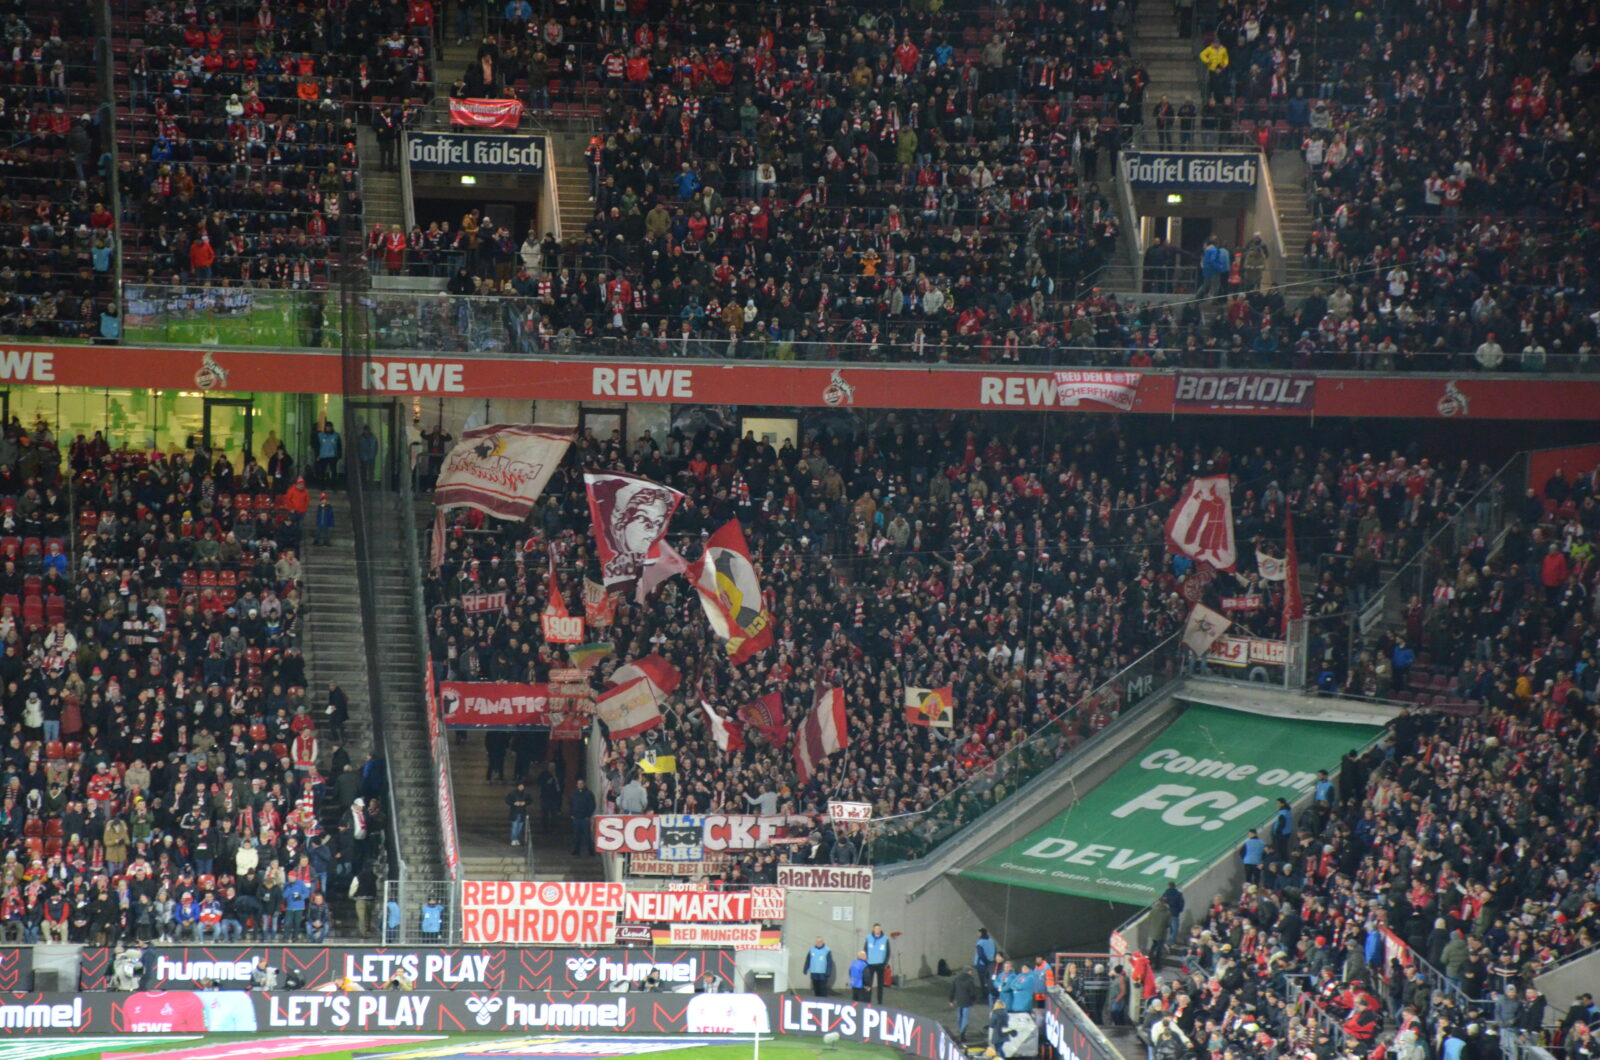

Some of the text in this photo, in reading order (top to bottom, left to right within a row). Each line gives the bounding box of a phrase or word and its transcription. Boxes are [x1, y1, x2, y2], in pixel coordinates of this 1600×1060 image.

[409, 136, 543, 169] Gaffel Kölsch
[1126, 156, 1256, 186] Gaffel Kölsch
[361, 362, 465, 392] REWE
[592, 367, 693, 398] REWE
[1055, 371, 1081, 382] TREU
[1083, 371, 1103, 382] DEN
[1175, 376, 1315, 403] BOCHOLT
[543, 616, 582, 636] 1900
[1140, 748, 1259, 781] Come
[831, 805, 844, 818] 13
[1111, 784, 1270, 831] FC!
[631, 861, 674, 874] IMMER
[678, 862, 699, 875] BEI
[1022, 837, 1200, 879] DEVK
[778, 869, 871, 890] alarMstufe
[463, 882, 623, 908] RED POWER
[625, 893, 751, 920] NEUMARKT
[752, 898, 783, 908] LAND
[463, 908, 616, 943] ROHRDORF
[674, 928, 697, 941] RED
[157, 955, 260, 981] hummel
[346, 954, 491, 982] LET'S PLAY
[599, 957, 697, 982] hummel
[269, 996, 431, 1027] LET'S PLAY
[506, 996, 627, 1027] hummel
[784, 1000, 857, 1036] LET'S
[862, 1007, 915, 1047] PLAY
